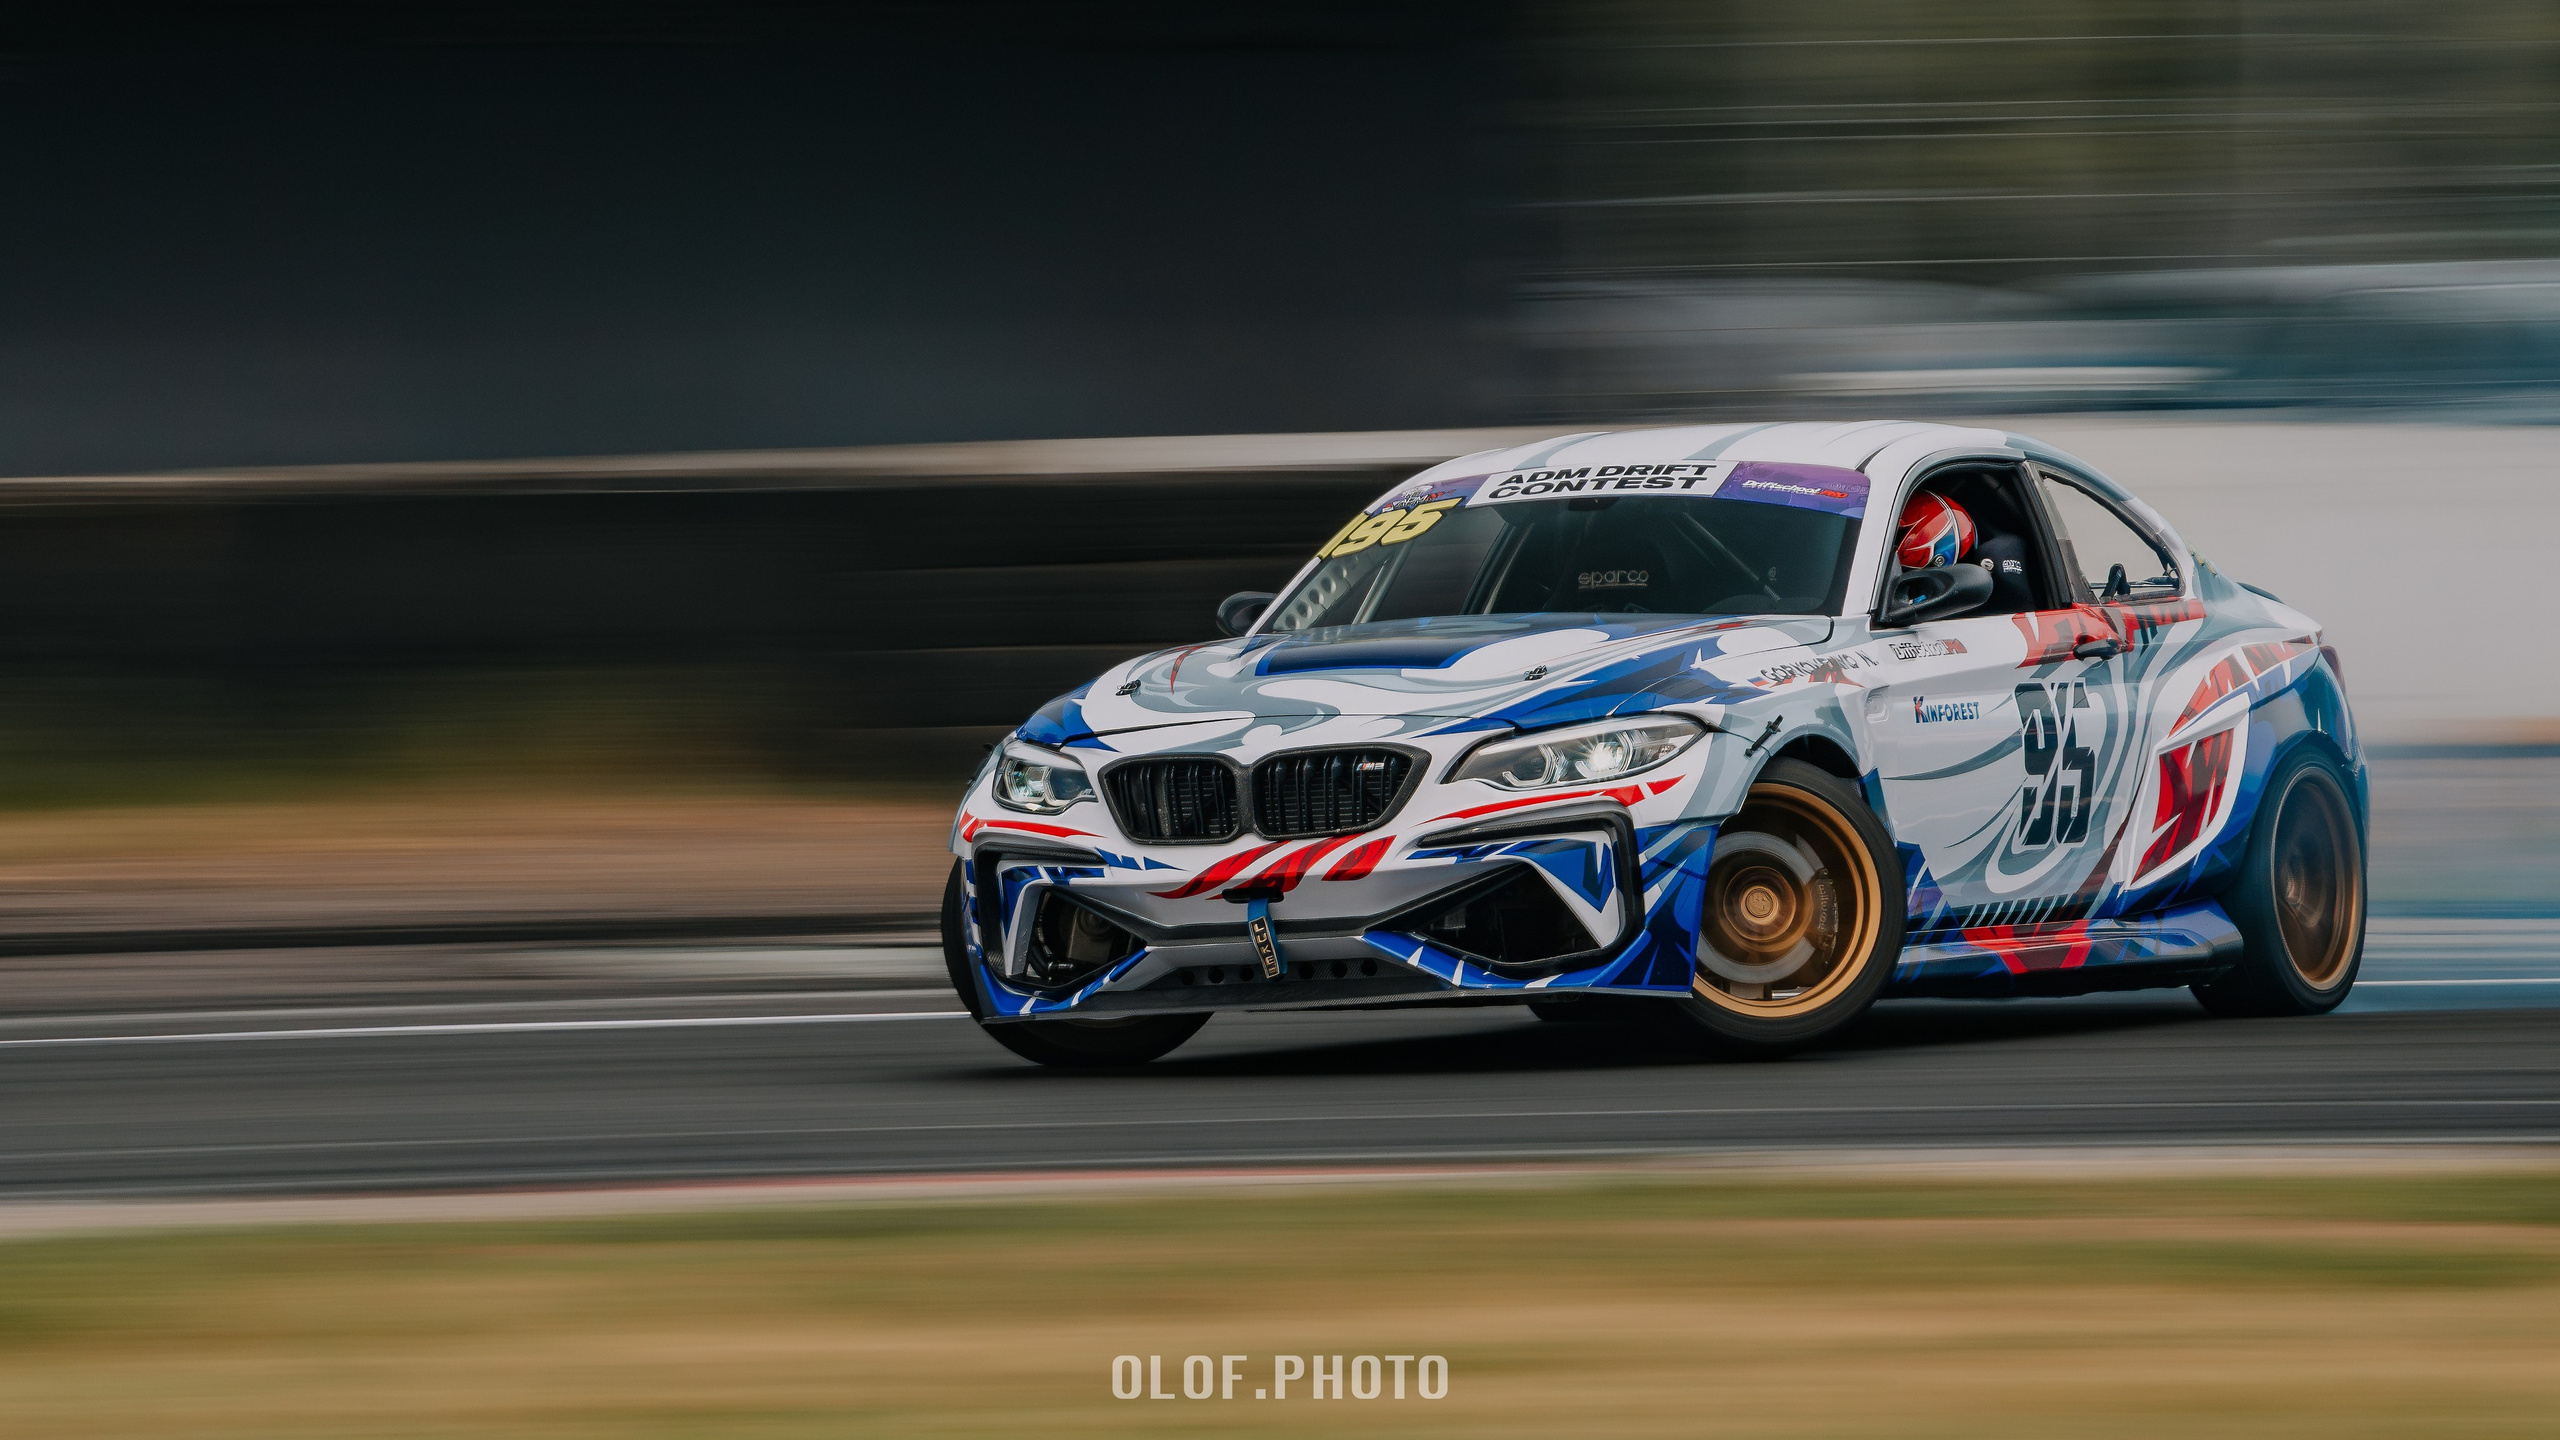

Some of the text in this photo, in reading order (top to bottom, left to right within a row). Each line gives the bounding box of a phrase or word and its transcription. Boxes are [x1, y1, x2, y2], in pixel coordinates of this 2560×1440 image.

[1488, 475, 1707, 499] CONTEST
[1497, 464, 1717, 487] ADM DRIFT
[1578, 569, 1650, 589] sparco
